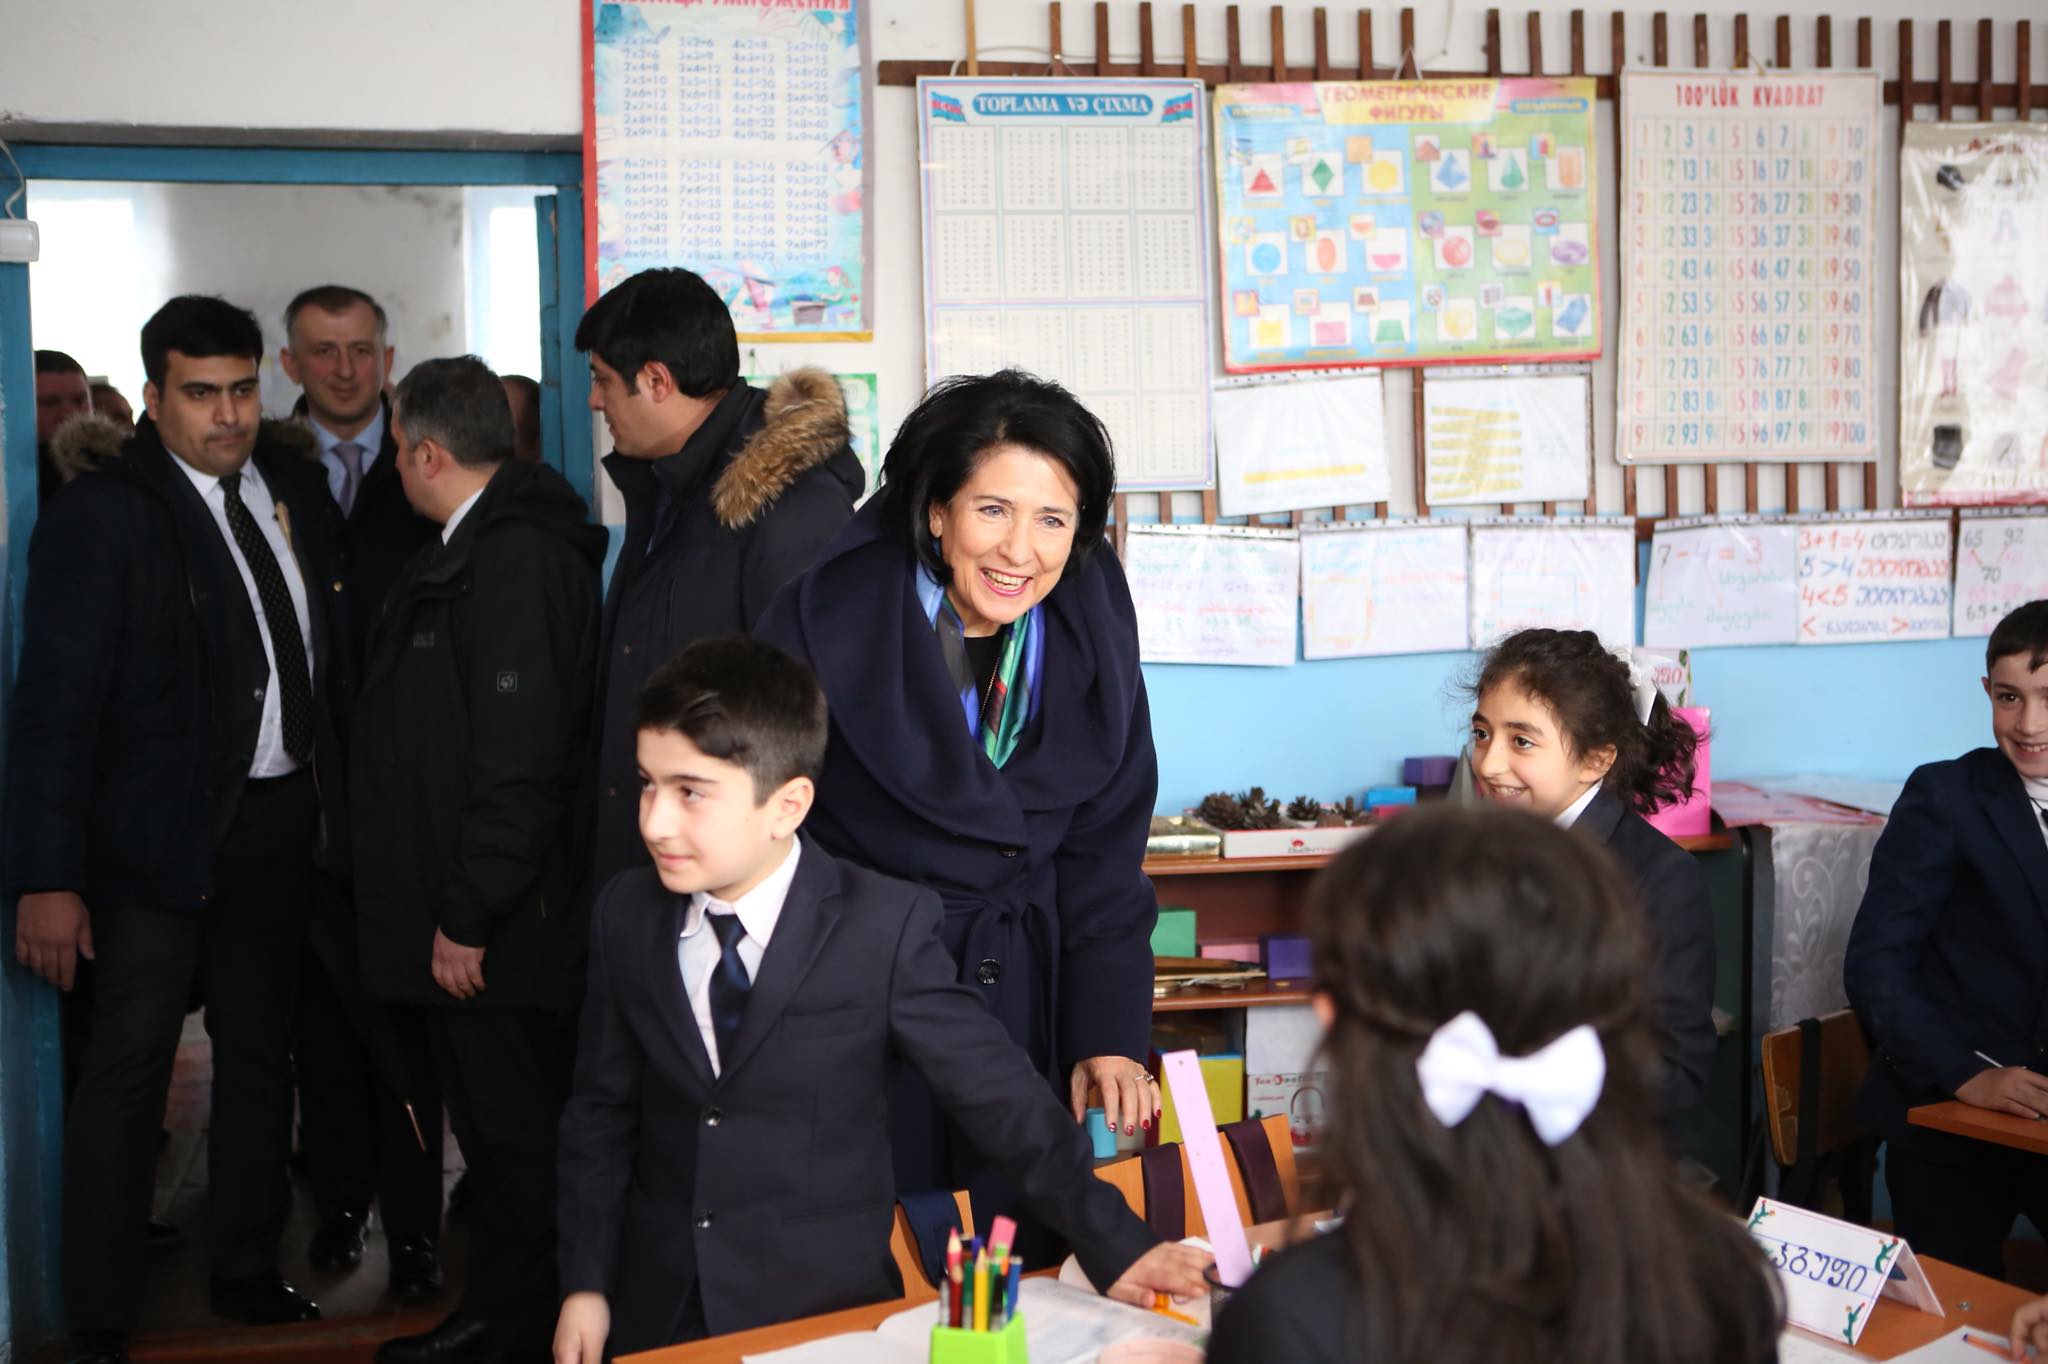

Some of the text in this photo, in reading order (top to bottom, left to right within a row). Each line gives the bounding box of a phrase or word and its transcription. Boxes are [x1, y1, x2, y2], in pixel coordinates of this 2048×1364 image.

[1321, 81, 1492, 104] ГЕОМЕТРИЧЕСКИЕ
[1674, 81, 1825, 107] 100'LÜK KVADRAT
[977, 96, 1149, 116] TOPLAMA VƏ ÇIXMA
[1368, 103, 1446, 122] ФИГУРЫ
[1664, 125, 1672, 148] 2
[1685, 125, 1694, 149] 3
[1707, 128, 1716, 145] 4
[1732, 125, 1740, 150] 5
[1756, 127, 1766, 148] 6
[1780, 125, 1788, 148] 7
[1848, 127, 1864, 151] 10
[1683, 159, 1697, 181] 13
[1752, 160, 1766, 181] 16
[1776, 158, 1790, 181] 17
[1845, 160, 1863, 183] 20
[1680, 192, 1698, 214] 23
[1750, 192, 1768, 214] 26
[1774, 192, 1790, 214] 27
[1843, 193, 1861, 216] 30
[1682, 224, 1860, 248] 33 36 37 40
[1681, 258, 1861, 282] 43 46 47 50
[1682, 290, 1860, 314] 53 56 57 60
[1681, 323, 1861, 347] 63 66 67 70
[1683, 356, 1860, 380] 73 76 77 80
[1683, 389, 1861, 412] 83 86 87 90
[1682, 421, 1866, 444] 93 96 97 100
[1657, 544, 1672, 568] 7
[1745, 536, 1763, 565] 3
[1982, 566, 2002, 584] 70
[1773, 1241, 1869, 1293] ჯგუფი
